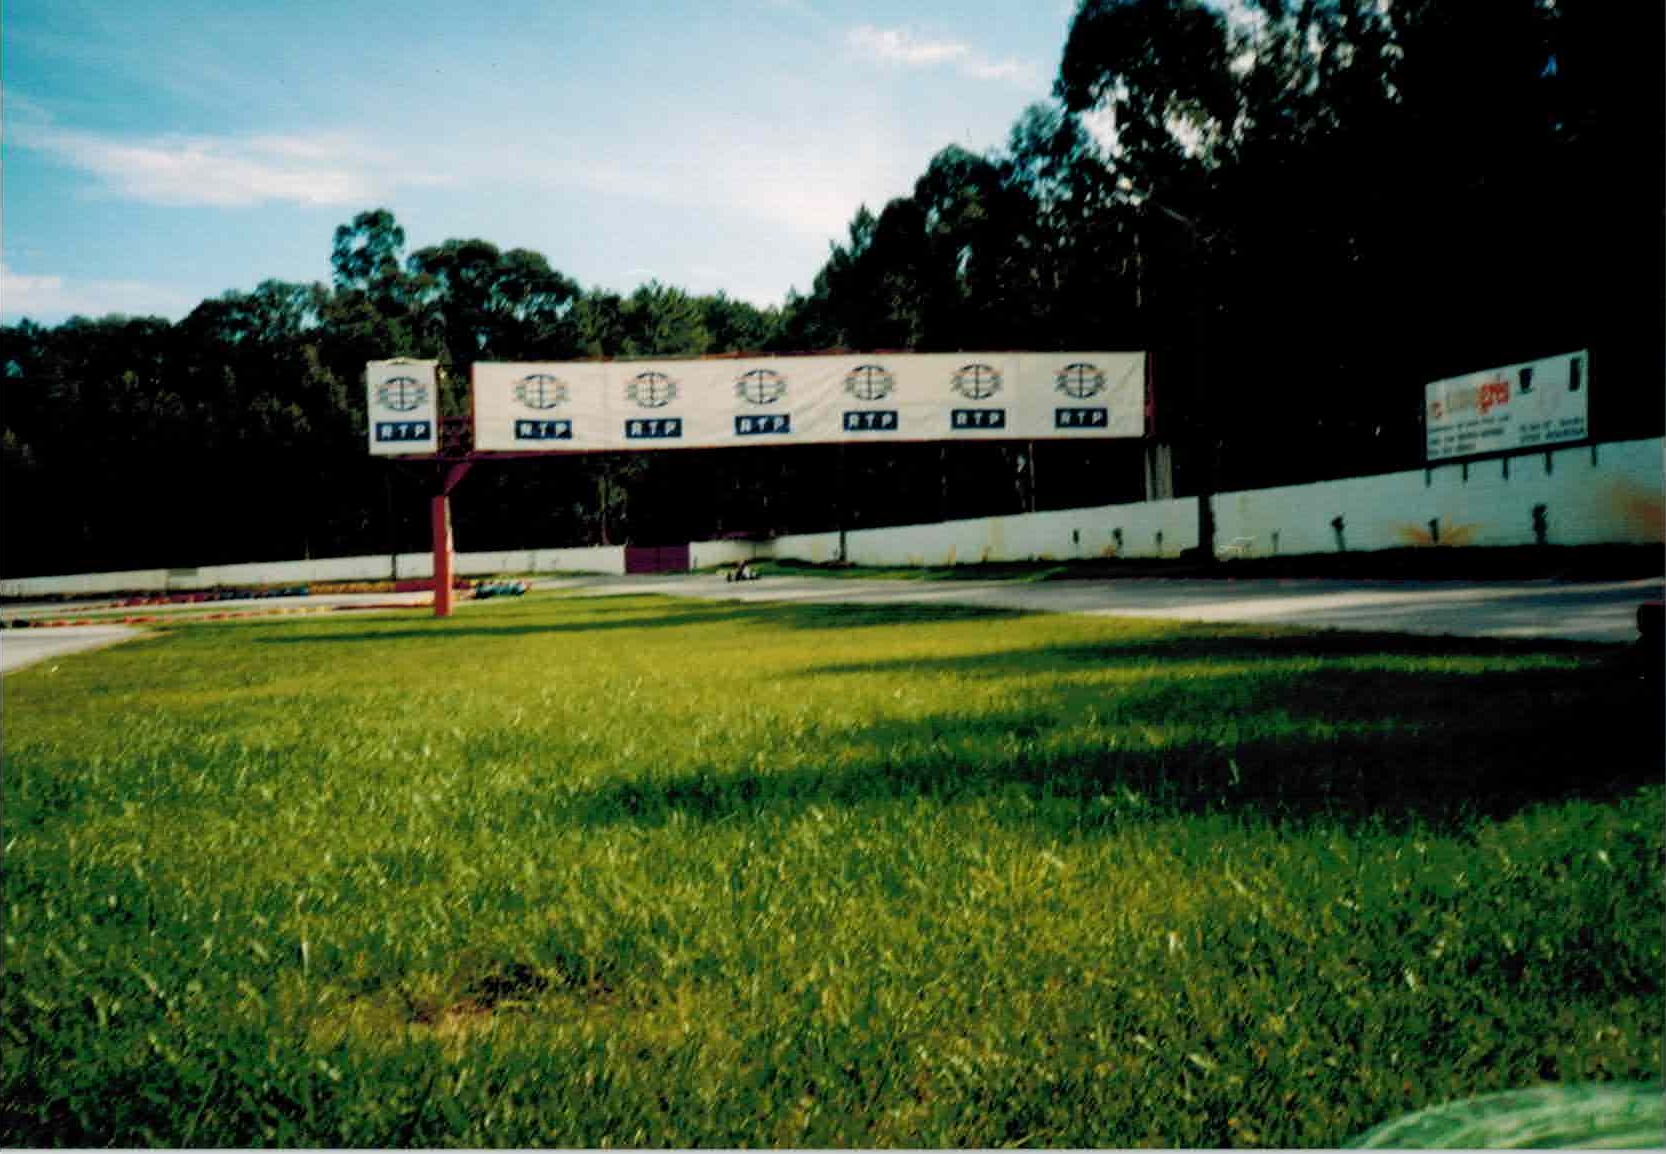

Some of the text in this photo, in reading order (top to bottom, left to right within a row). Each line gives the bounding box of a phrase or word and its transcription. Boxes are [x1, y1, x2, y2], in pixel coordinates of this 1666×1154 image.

[740, 416, 785, 432] RTP
[847, 413, 893, 429] RTP
[956, 411, 1000, 426] RTP
[1059, 410, 1104, 425] RTP
[380, 422, 426, 438] RTP
[519, 421, 567, 438] RTP
[630, 420, 677, 436] RTP
